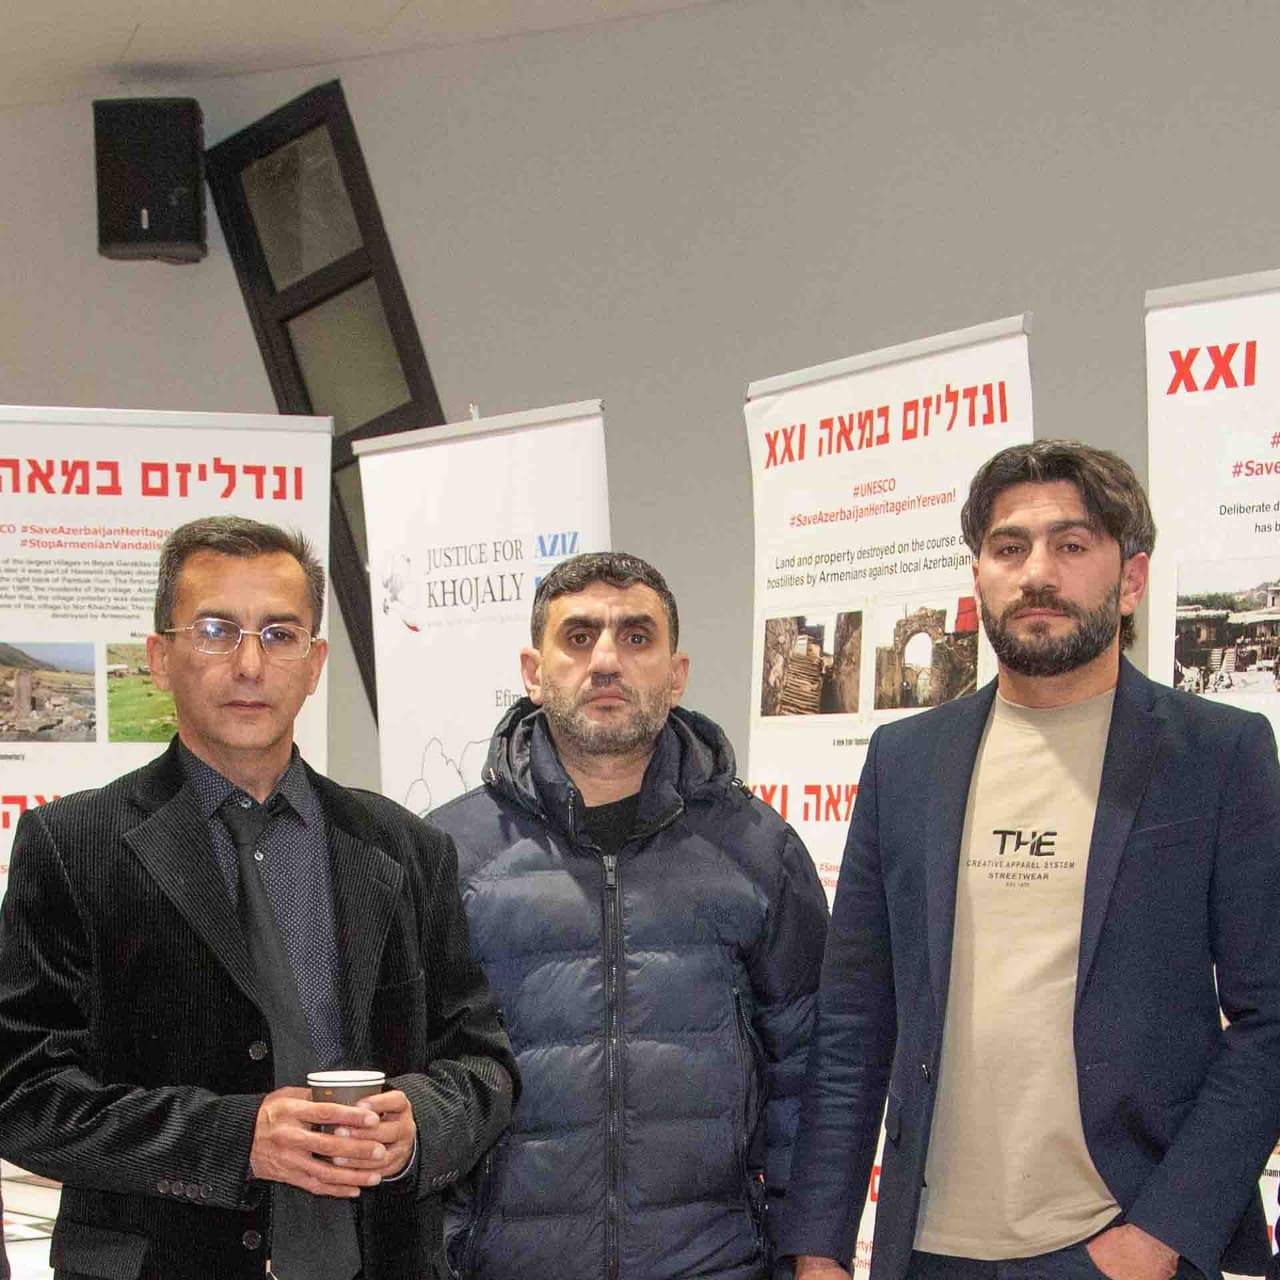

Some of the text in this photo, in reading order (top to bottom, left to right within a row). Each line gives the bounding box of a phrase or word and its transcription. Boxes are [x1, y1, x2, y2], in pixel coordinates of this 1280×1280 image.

[1166, 339, 1257, 395] XXI
[764, 380, 1009, 469] ונדליזם במאה XXI
[140, 456, 304, 501] ונדליזם
[852, 477, 897, 499] #UNESCO
[1219, 500, 1271, 517] Deliberate
[1254, 521, 1274, 534] has
[19, 538, 161, 551] #StopArmenianVandalis
[425, 539, 524, 574] JUSTICE FOR
[775, 555, 795, 570] Land
[796, 552, 813, 567] and
[814, 550, 855, 569] property
[856, 541, 896, 560] destroyed
[897, 542, 910, 554] on
[911, 537, 925, 552] the
[926, 536, 957, 551] course
[766, 575, 805, 591] hostilities
[806, 573, 816, 588] by
[819, 566, 868, 583] Armenians
[868, 562, 898, 581] against
[899, 559, 921, 574] local
[425, 572, 525, 612] KHOJALY
[992, 829, 1058, 857] THE
[966, 860, 1003, 869] CREATIVE
[987, 871, 1049, 881] STREETWEAR
